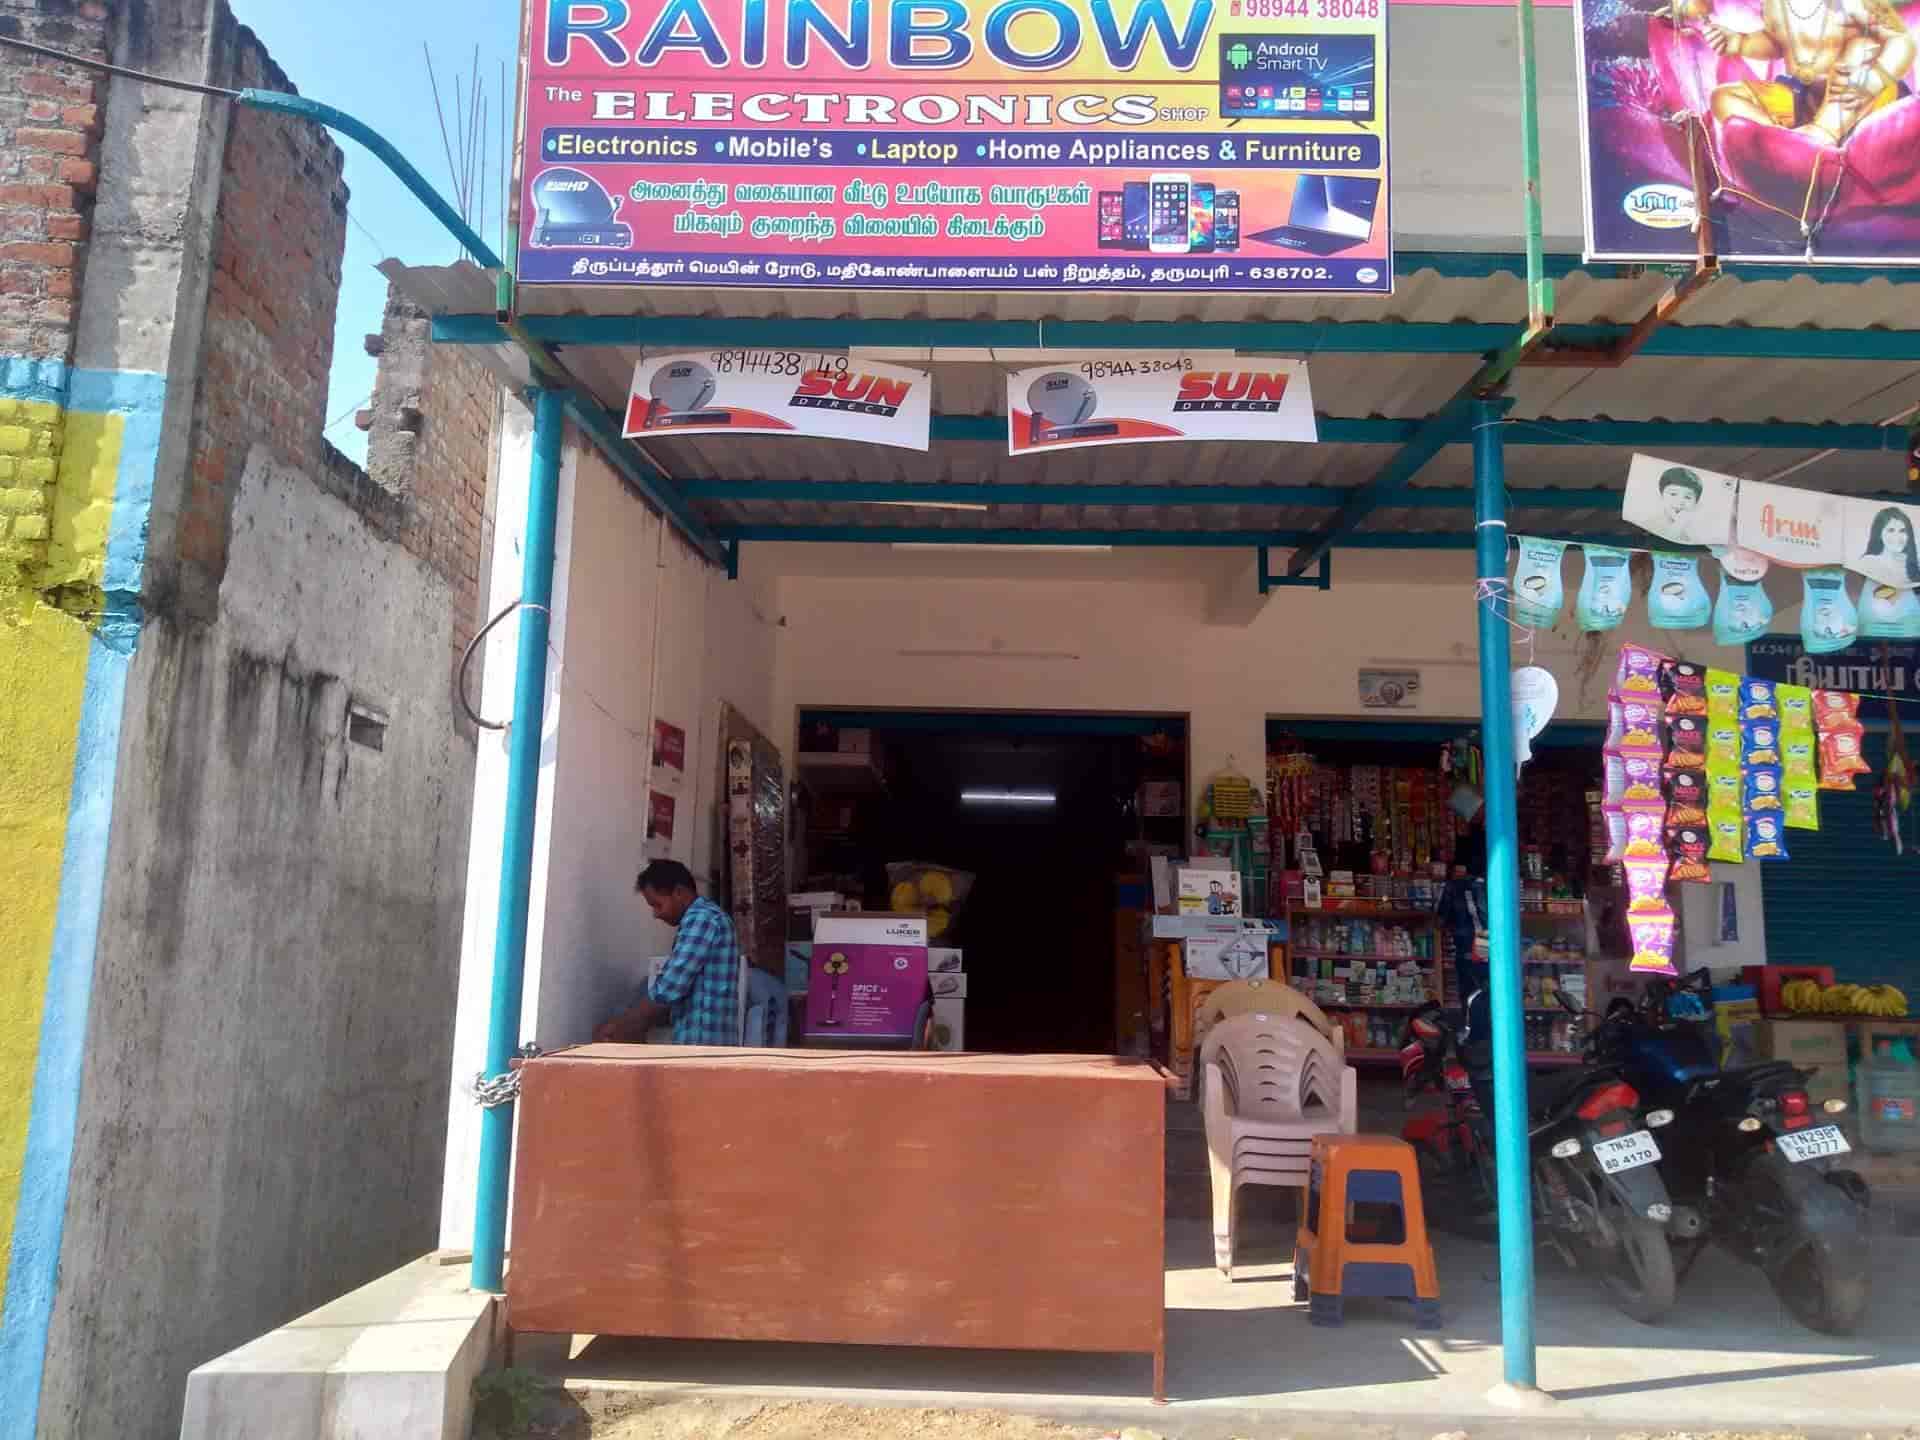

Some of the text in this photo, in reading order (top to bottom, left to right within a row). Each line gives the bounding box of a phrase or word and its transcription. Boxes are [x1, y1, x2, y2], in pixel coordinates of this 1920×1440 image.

[1246, 0, 1380, 18] 98944 38048
[544, 0, 1216, 72] RAINBOW
[1256, 42, 1319, 56] Android
[1257, 57, 1328, 71] Smart TV
[545, 86, 1209, 126] The ELECTRONICS SHOP
[557, 134, 1362, 165] Electronics Mobile's Laptop Home Appliances & Furniture
[630, 178, 1093, 209] அனைத்து வகையான வீட்டு உபயோக பொருட்கள்
[674, 211, 1047, 243] மிகவும் குறைந்த விலையில் கிடைக்கும்
[571, 257, 685, 278] திருப்பத்தூர்
[689, 259, 760, 276] மெயின்
[826, 261, 1018, 280] மதிகோண்பாளையம்
[1023, 263, 1058, 279] பஸ்
[1151, 264, 1230, 283] தருமபுரி
[795, 367, 912, 408] SUN
[1177, 371, 1289, 401] SUN
[796, 397, 893, 416] DIRECT
[1181, 401, 1277, 411] DIRECT
